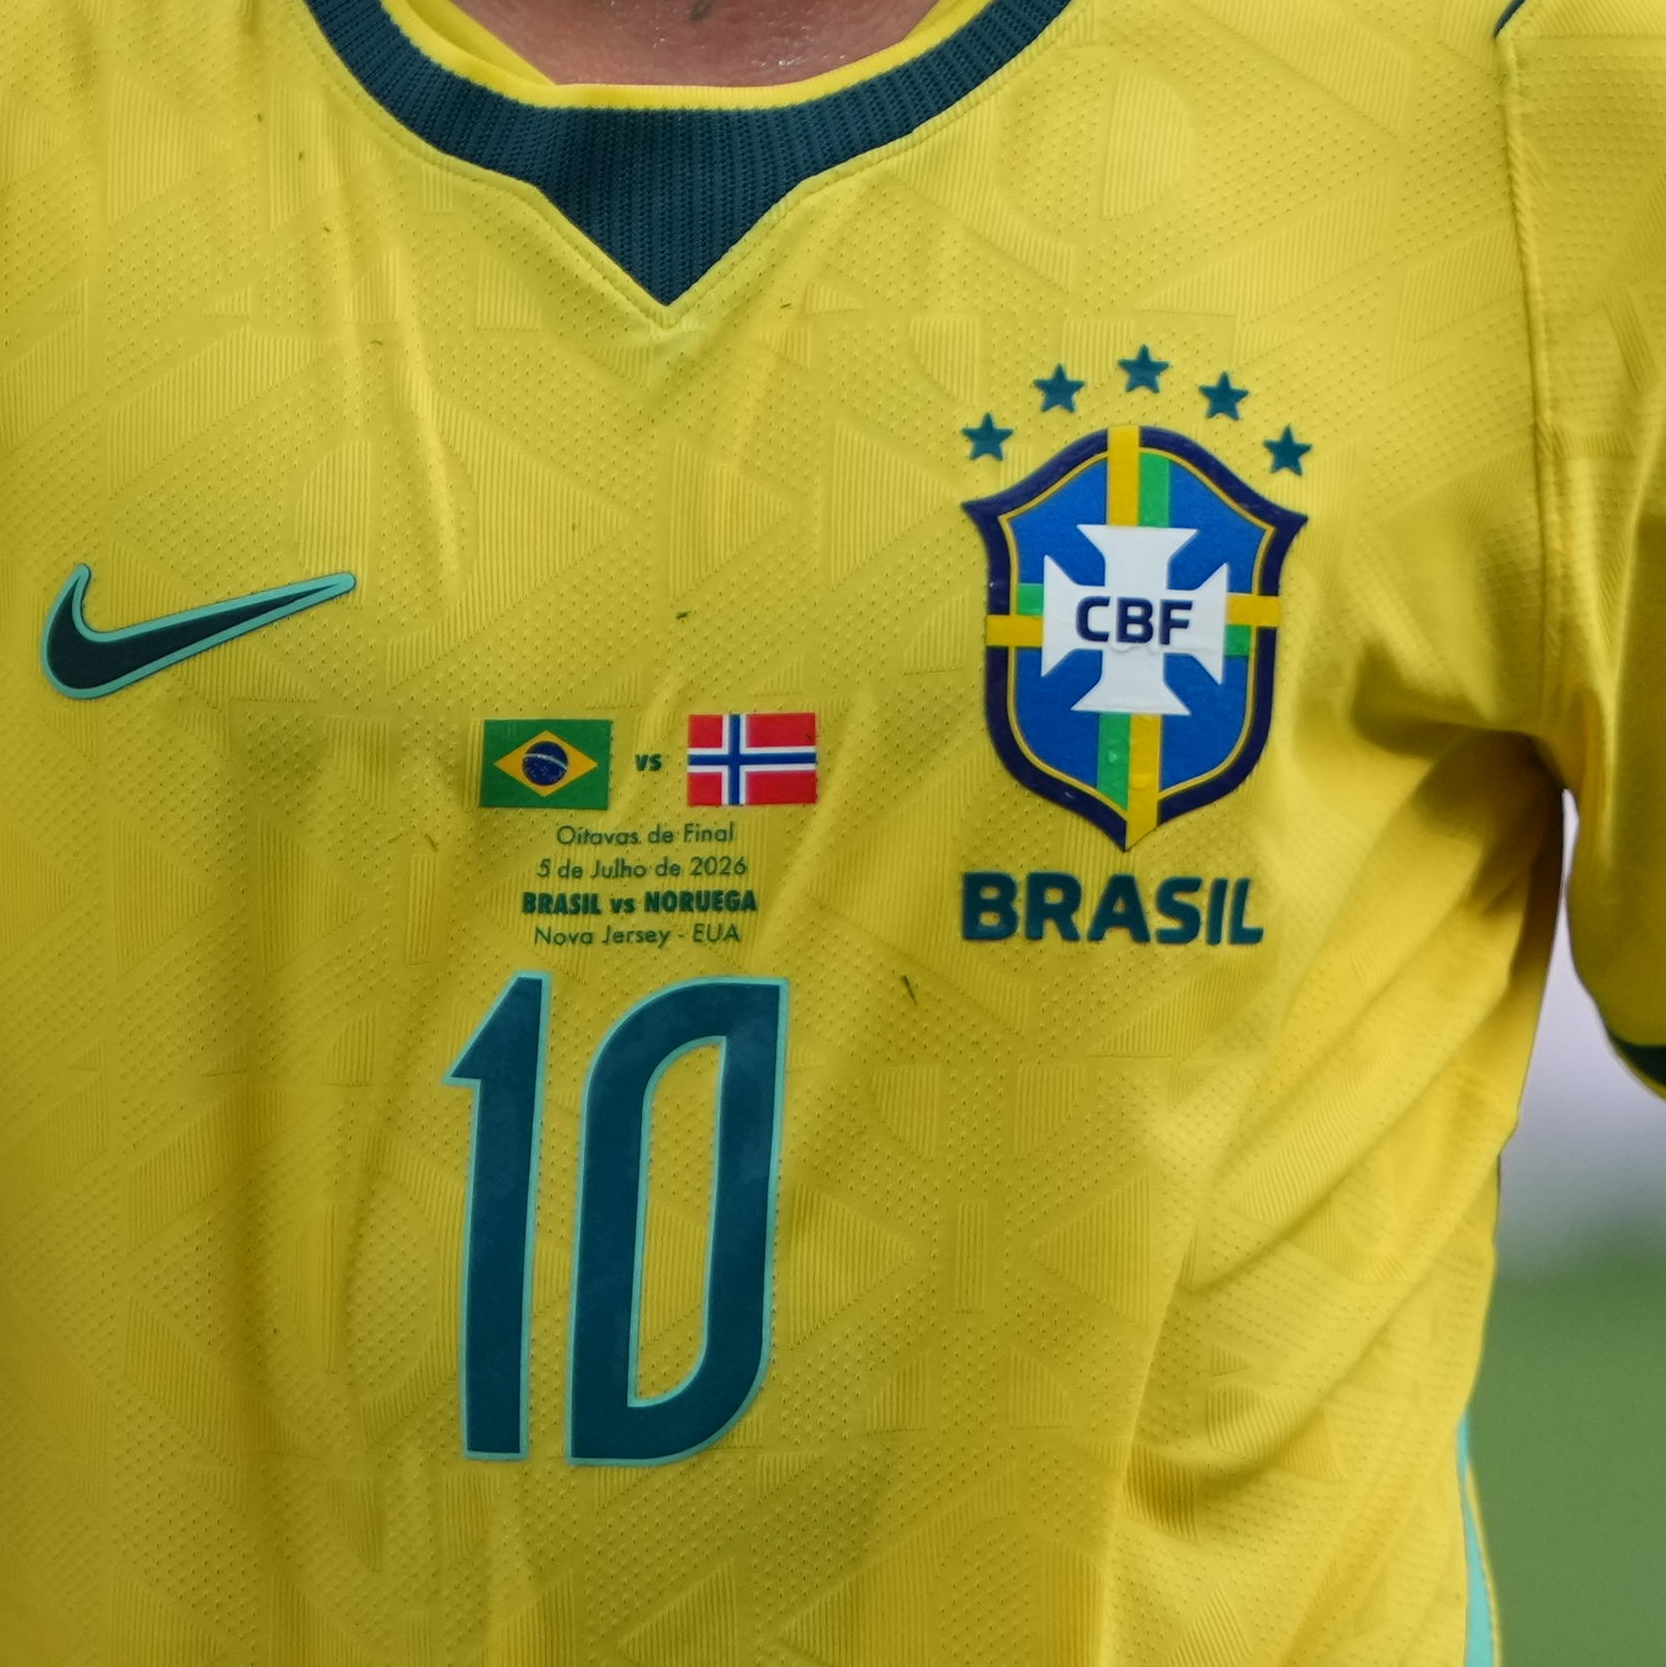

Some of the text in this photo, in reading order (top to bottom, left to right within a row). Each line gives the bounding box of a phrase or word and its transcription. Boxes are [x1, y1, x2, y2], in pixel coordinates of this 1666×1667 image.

[1075, 594, 1194, 646] CBF
[556, 822, 735, 845] Oitavas de Final
[536, 855, 748, 879] 5 de Julho de 2026
[521, 889, 758, 914] BRASIL vs NORUEGA
[959, 870, 1265, 947] BRASIL
[534, 926, 594, 946] Nova
[602, 925, 671, 948] Jersey
[692, 924, 741, 942] EUA
[441, 969, 789, 1466] 10
